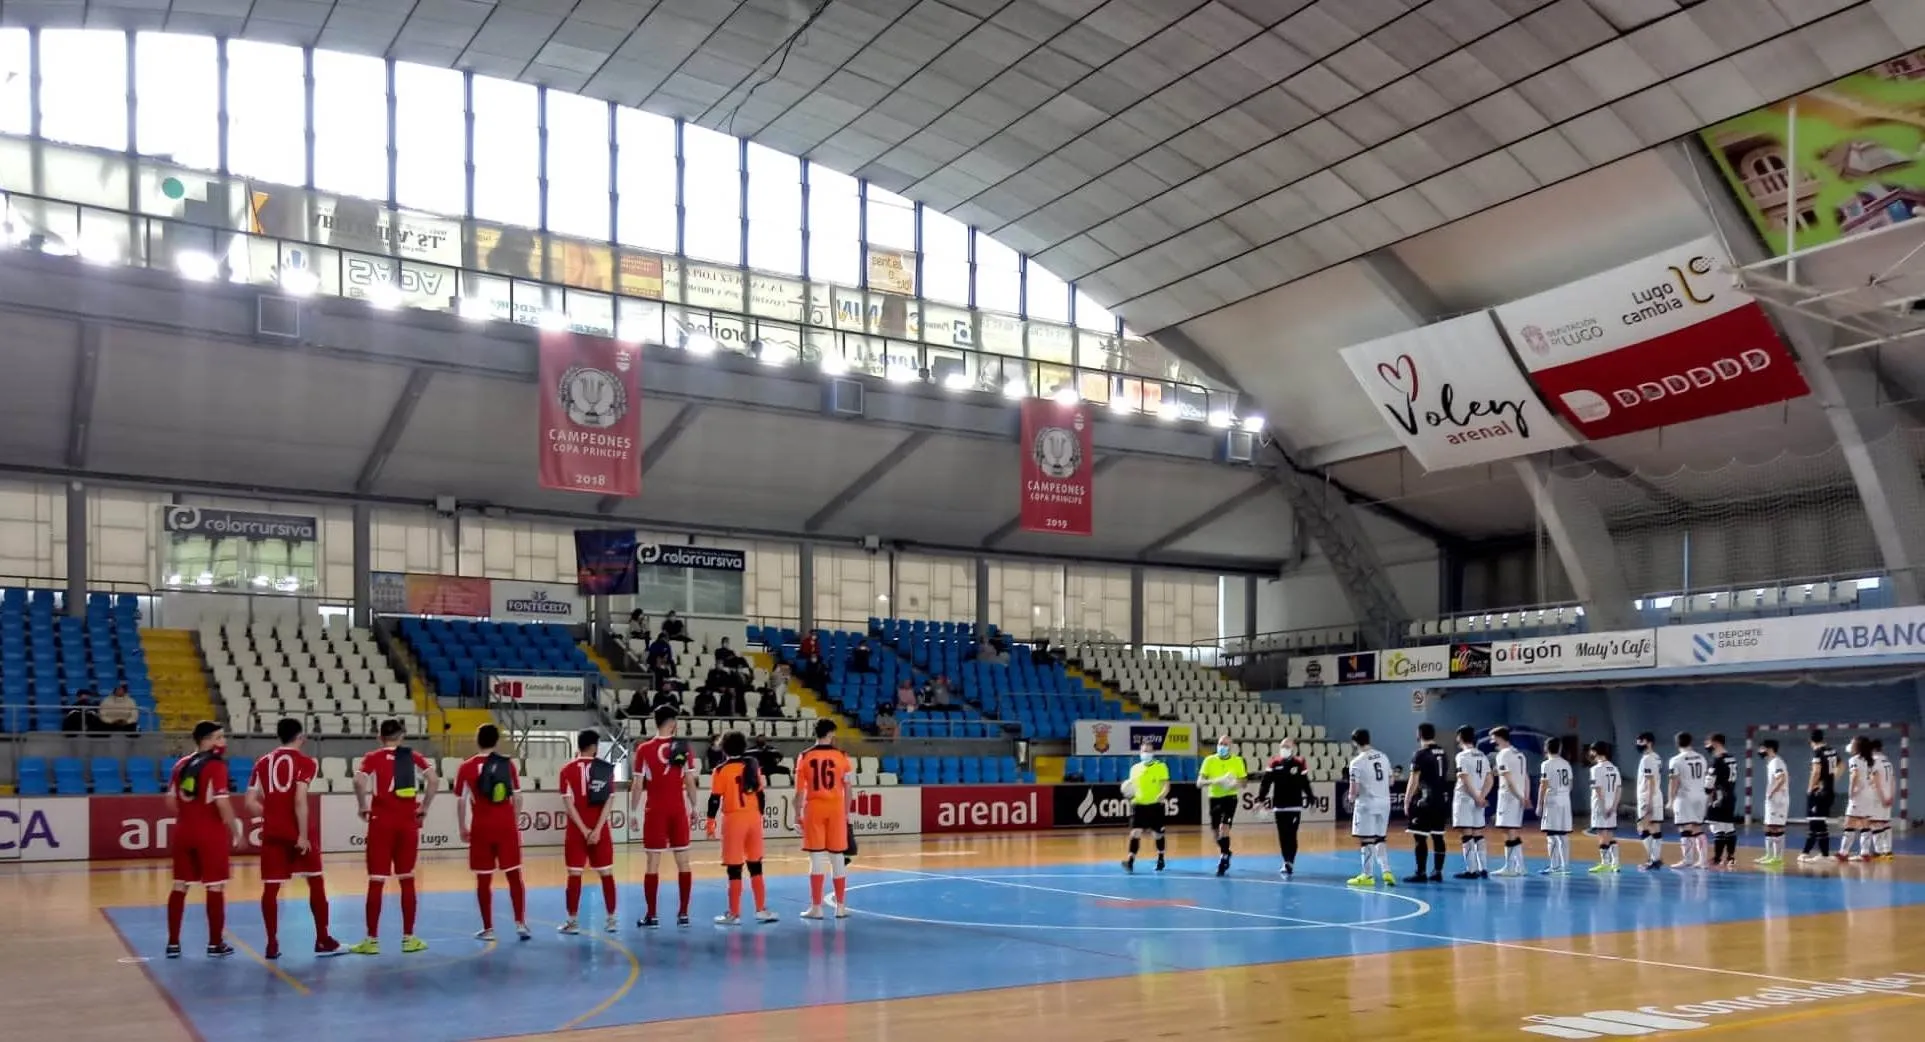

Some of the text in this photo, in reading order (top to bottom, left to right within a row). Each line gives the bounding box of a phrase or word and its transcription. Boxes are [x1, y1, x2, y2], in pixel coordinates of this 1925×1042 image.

[1632, 282, 1674, 306] Lugo
[1621, 297, 1684, 326] cambia
[1561, 325, 1604, 347] LUGO
[1384, 383, 1530, 439] Voley
[549, 428, 632, 449] CAMPEONES
[1446, 420, 1514, 445] arenal
[553, 443, 580, 455] COPA
[575, 473, 606, 486] 2018
[1027, 480, 1085, 496] CAMPEONES
[1030, 491, 1050, 502] COPA
[204, 514, 313, 538] colorcursiva
[1046, 518, 1068, 529] 2019
[662, 549, 743, 569] colorcursiva
[507, 600, 572, 615] FONTECELTA
[1718, 628, 1763, 640] DEPORTE
[1718, 638, 1759, 649] GALEGO
[1495, 640, 1562, 664] ofigón
[1622, 638, 1651, 658] Café
[1394, 656, 1443, 677] Galeno
[267, 753, 294, 793] 10
[809, 758, 836, 792] 16
[1373, 761, 1384, 781] 6
[1436, 756, 1443, 777] 1
[1475, 759, 1483, 778] 4
[1687, 762, 1703, 779] 10
[1556, 768, 1570, 787] 18
[1605, 773, 1617, 793] 17
[937, 791, 1038, 827] arenal
[880, 820, 900, 832] Lugo
[420, 833, 449, 846] Lugo
